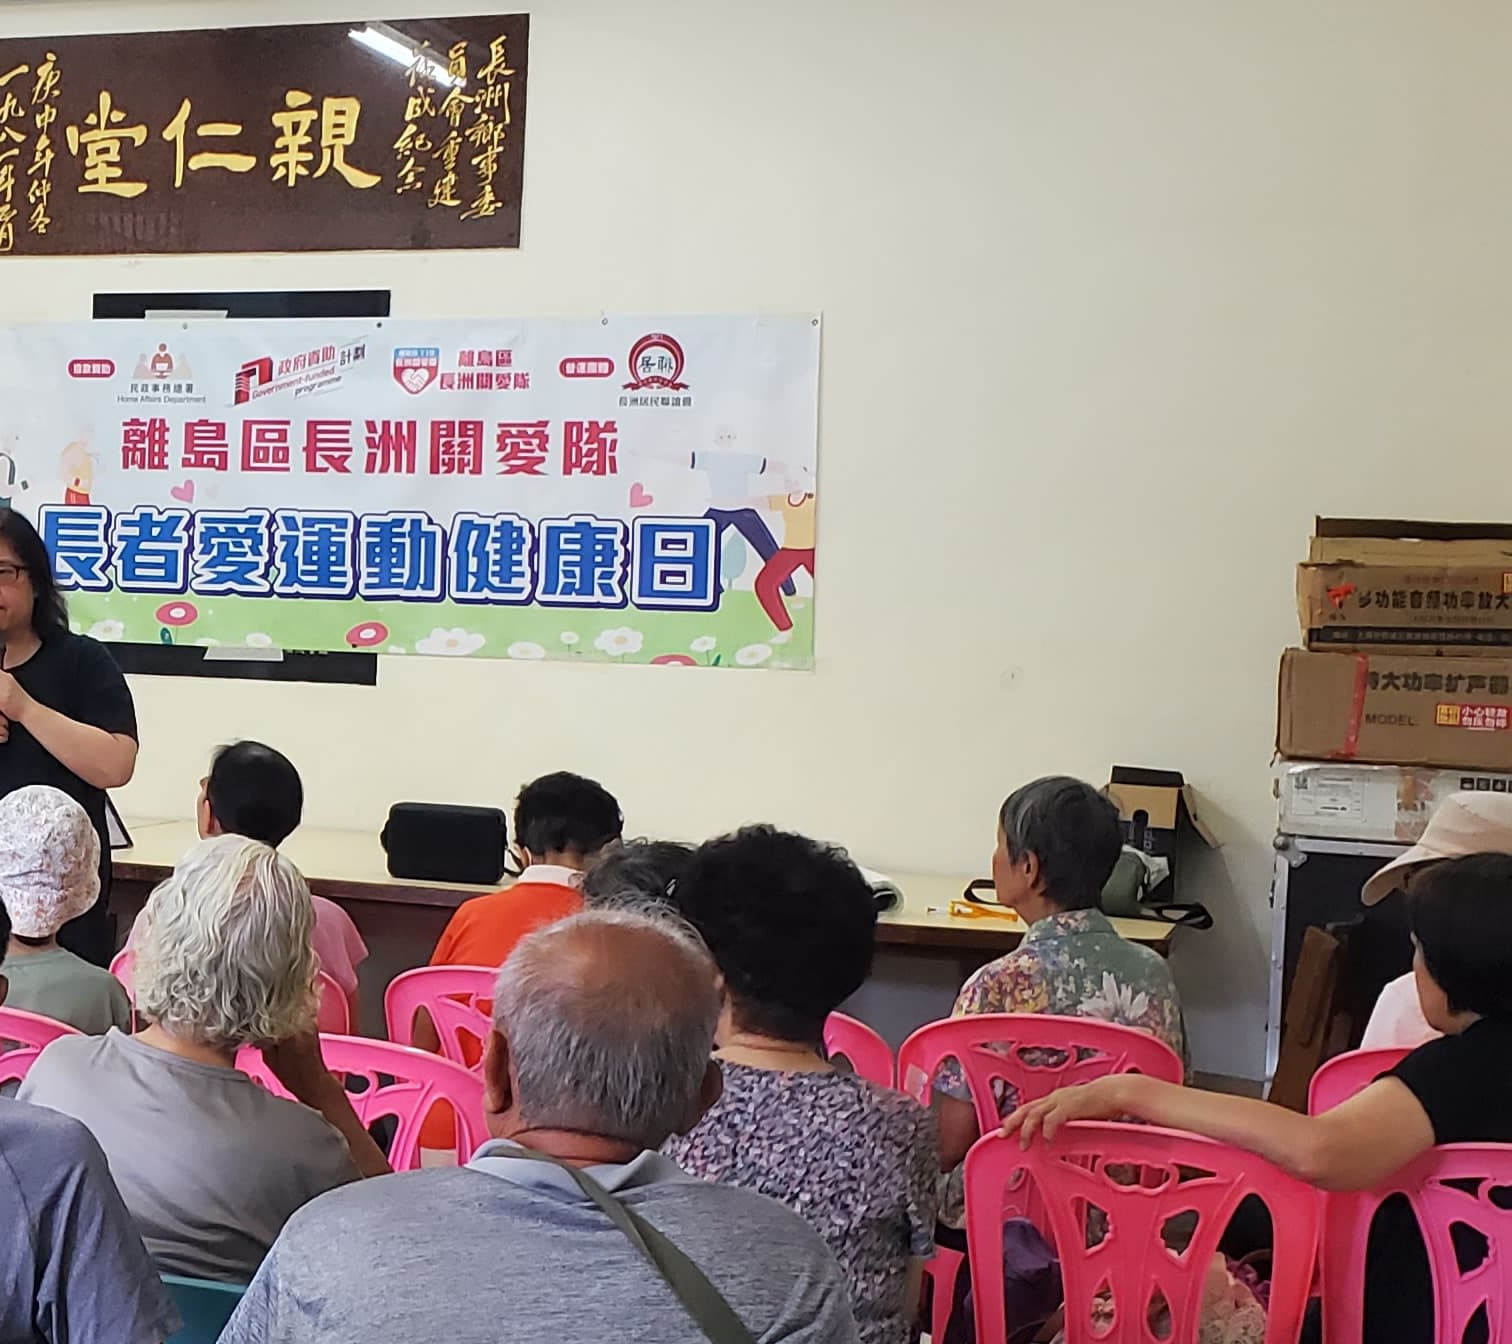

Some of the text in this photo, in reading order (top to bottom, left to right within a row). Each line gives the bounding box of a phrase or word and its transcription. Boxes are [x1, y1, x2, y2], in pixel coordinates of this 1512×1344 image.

[65, 89, 381, 199] 親仁堂
[121, 418, 620, 478] 離島區長洲關愛隊
[40, 506, 720, 610] 長者愛運動健康日
